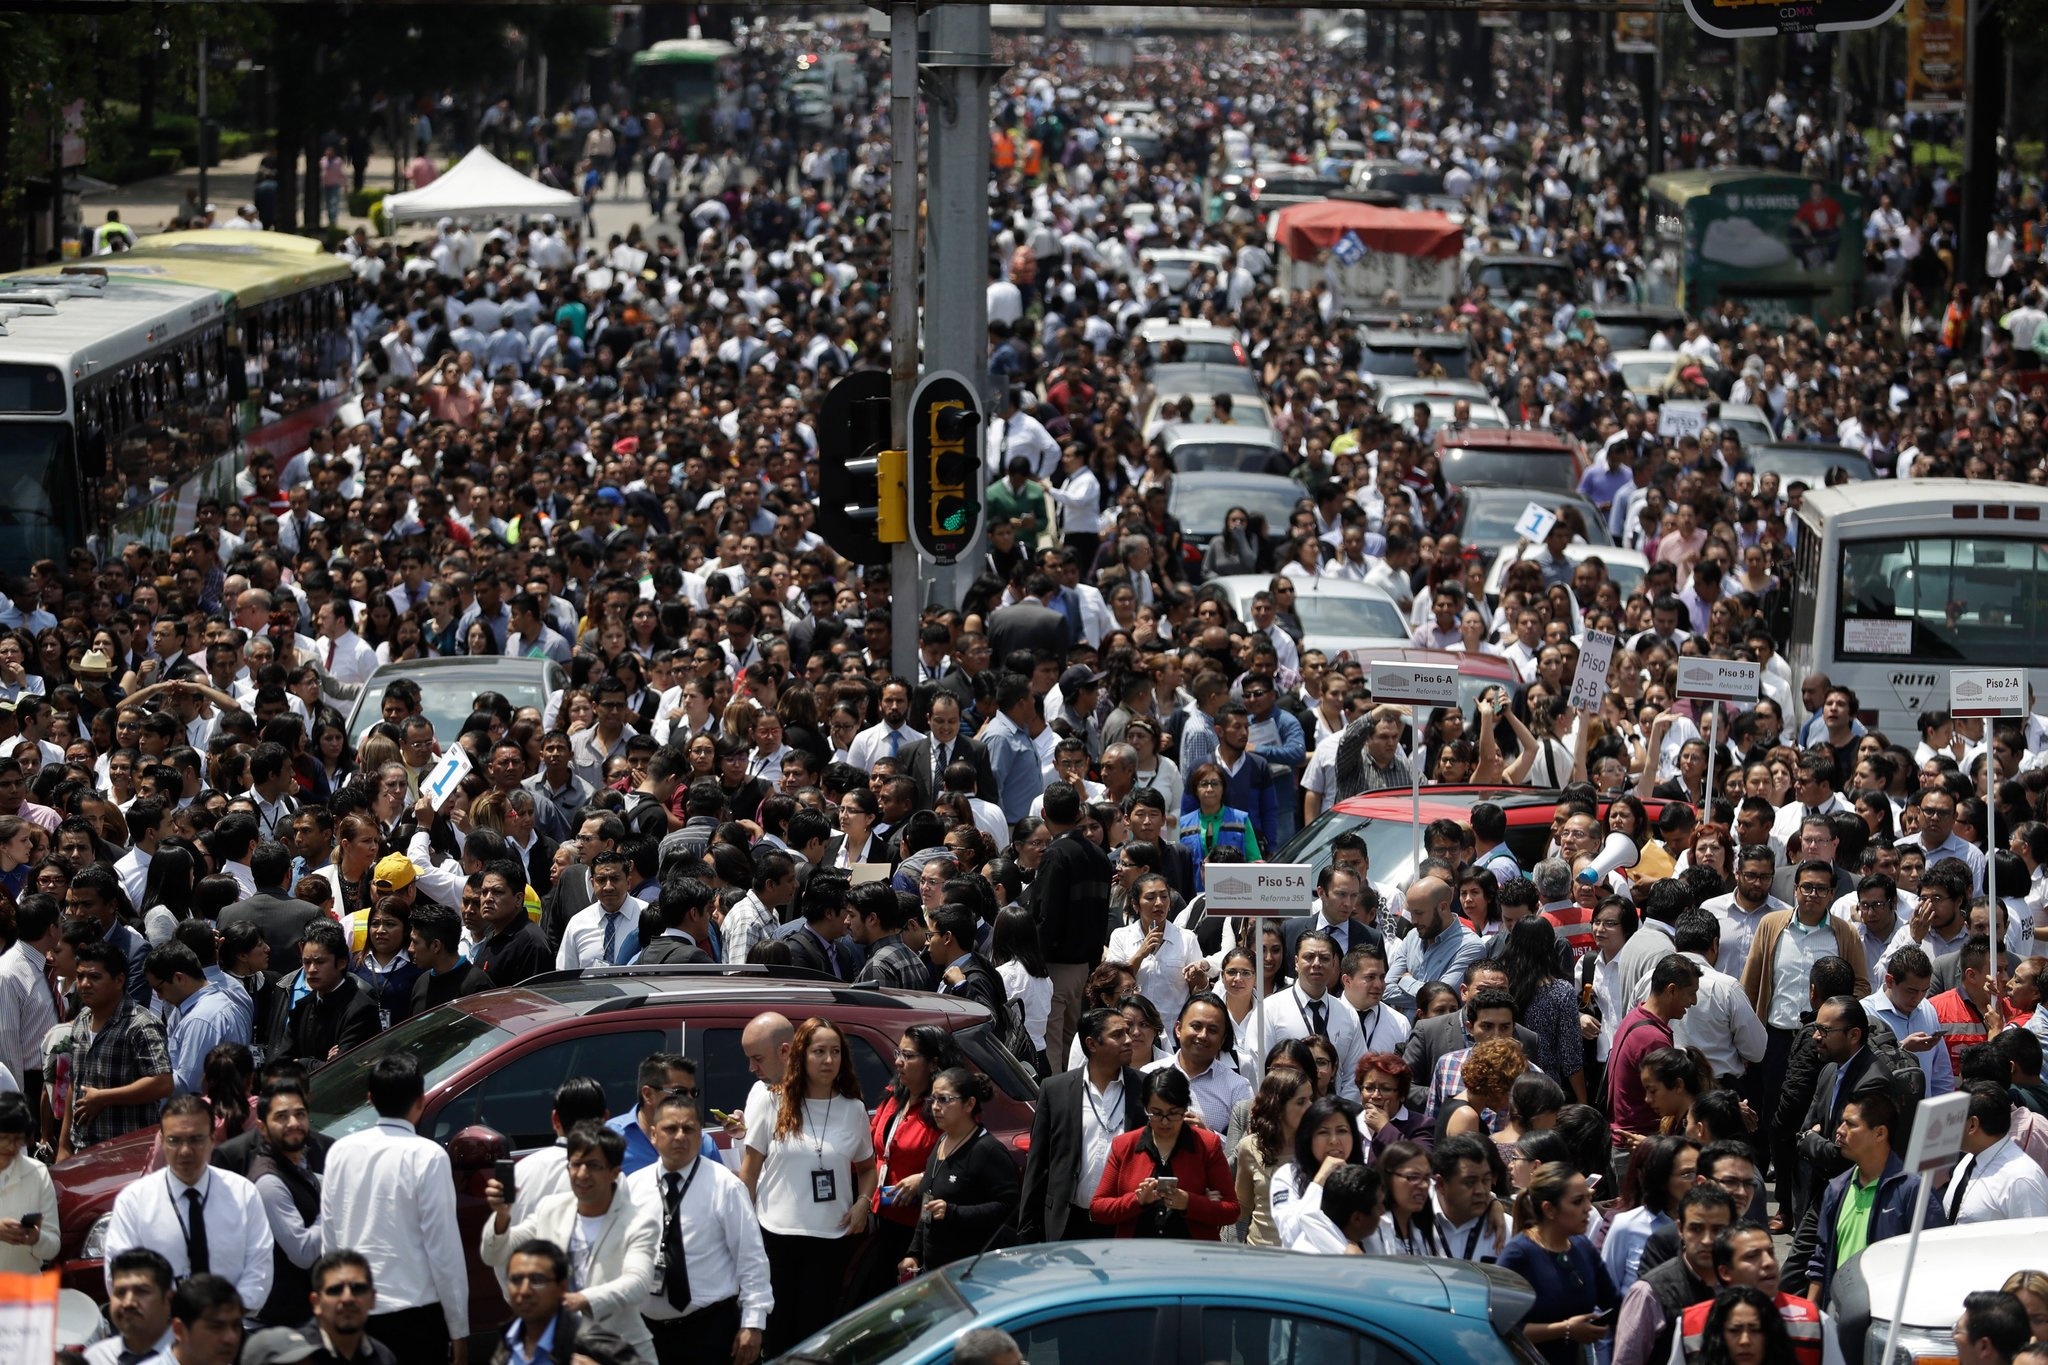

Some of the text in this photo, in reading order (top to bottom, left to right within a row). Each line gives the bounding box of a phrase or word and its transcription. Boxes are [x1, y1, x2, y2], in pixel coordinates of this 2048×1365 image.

[1780, 7, 1813, 18] CDMX
[1526, 513, 1544, 534] 1
[1582, 652, 1606, 672] Piso
[1414, 673, 1453, 684] Piso 6-A
[1719, 668, 1755, 679] Piso 9-B
[1892, 672, 1936, 686] RUTA
[1575, 678, 1598, 697] 8-B
[1986, 678, 2019, 688] Piso 2-A
[1415, 687, 1440, 695] Reforma
[1909, 696, 1920, 709] 2
[432, 760, 459, 797] 1
[1258, 876, 1305, 887] Piso 5-A
[1260, 894, 1290, 903] Reforma
